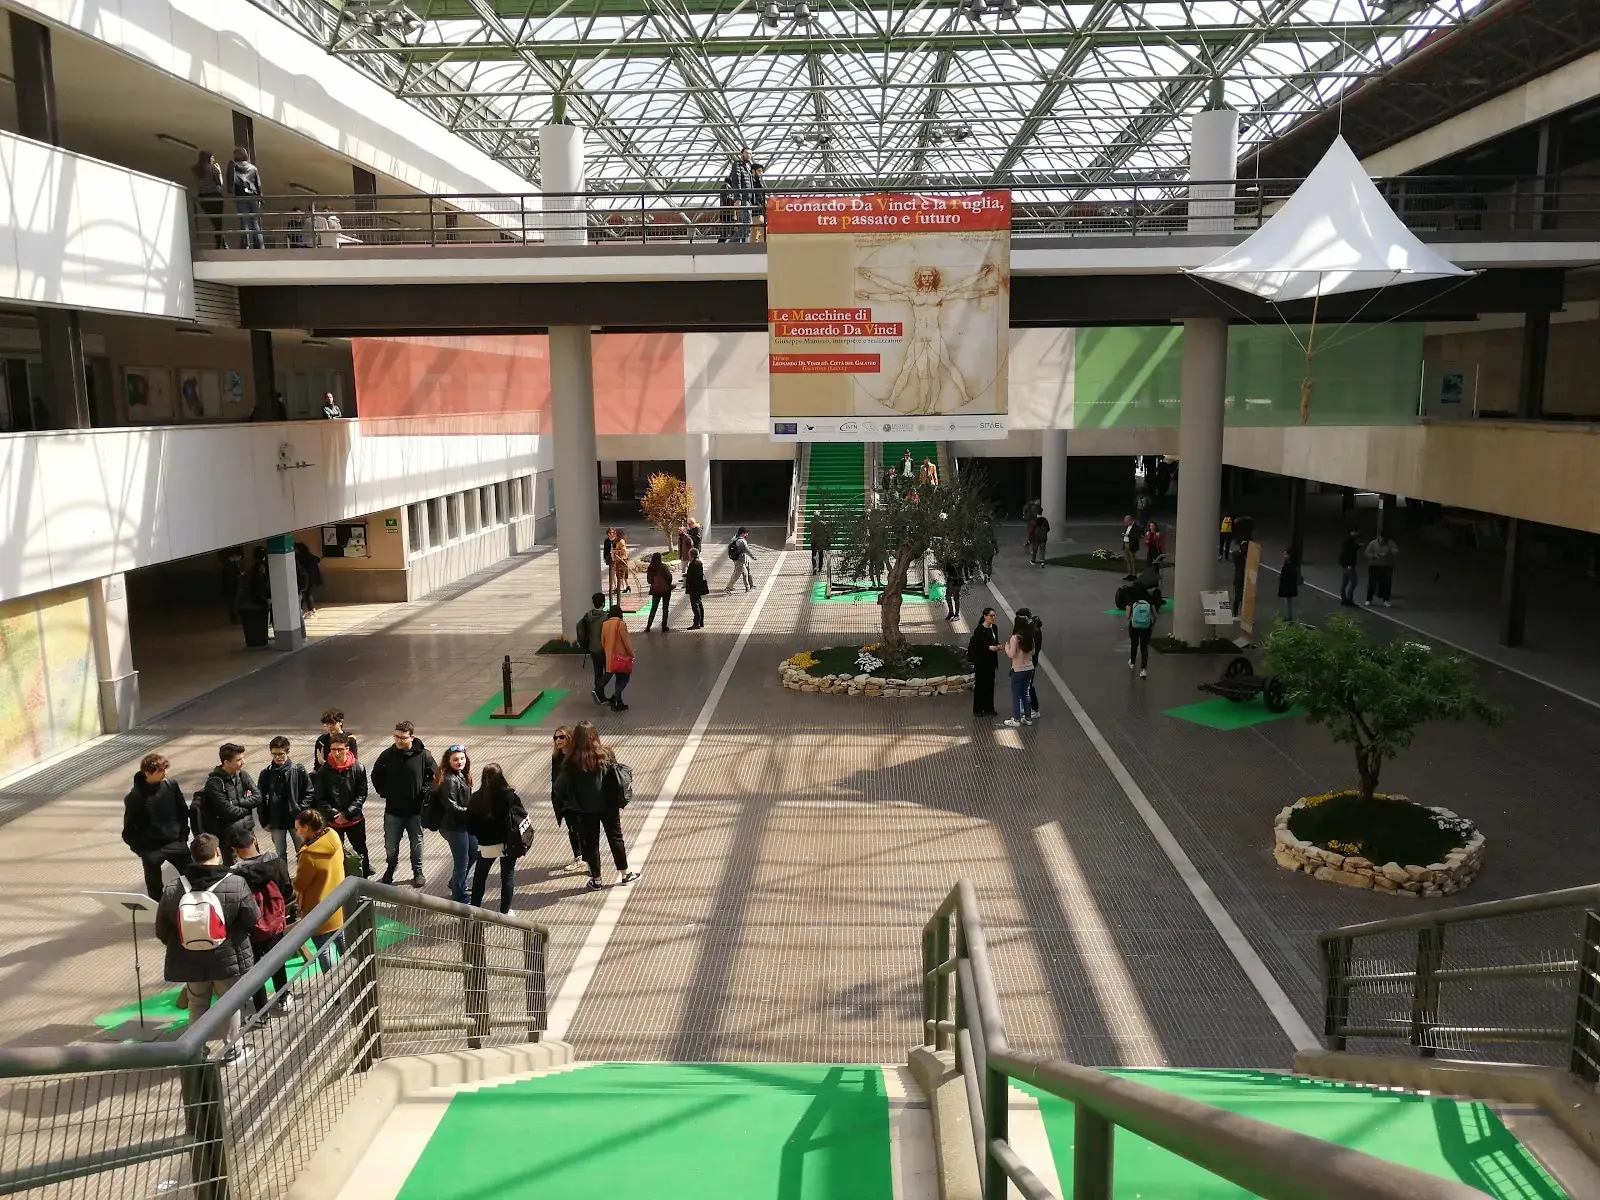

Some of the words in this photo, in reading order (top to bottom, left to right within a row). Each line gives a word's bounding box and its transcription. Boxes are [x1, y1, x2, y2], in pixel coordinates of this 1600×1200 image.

[773, 198, 846, 212] Leonardo
[850, 198, 873, 211] Da
[876, 197, 917, 211] Vinci
[933, 198, 947, 210] la
[951, 197, 1004, 214] Puglia,
[817, 214, 838, 225] tra
[841, 214, 898, 230] passato
[915, 211, 961, 224] futuro
[772, 309, 789, 321] Le
[792, 309, 852, 321] Macchine
[854, 309, 868, 321] di
[782, 324, 840, 336] Leonardo
[843, 324, 862, 335] Da
[865, 323, 898, 335] Vinci
